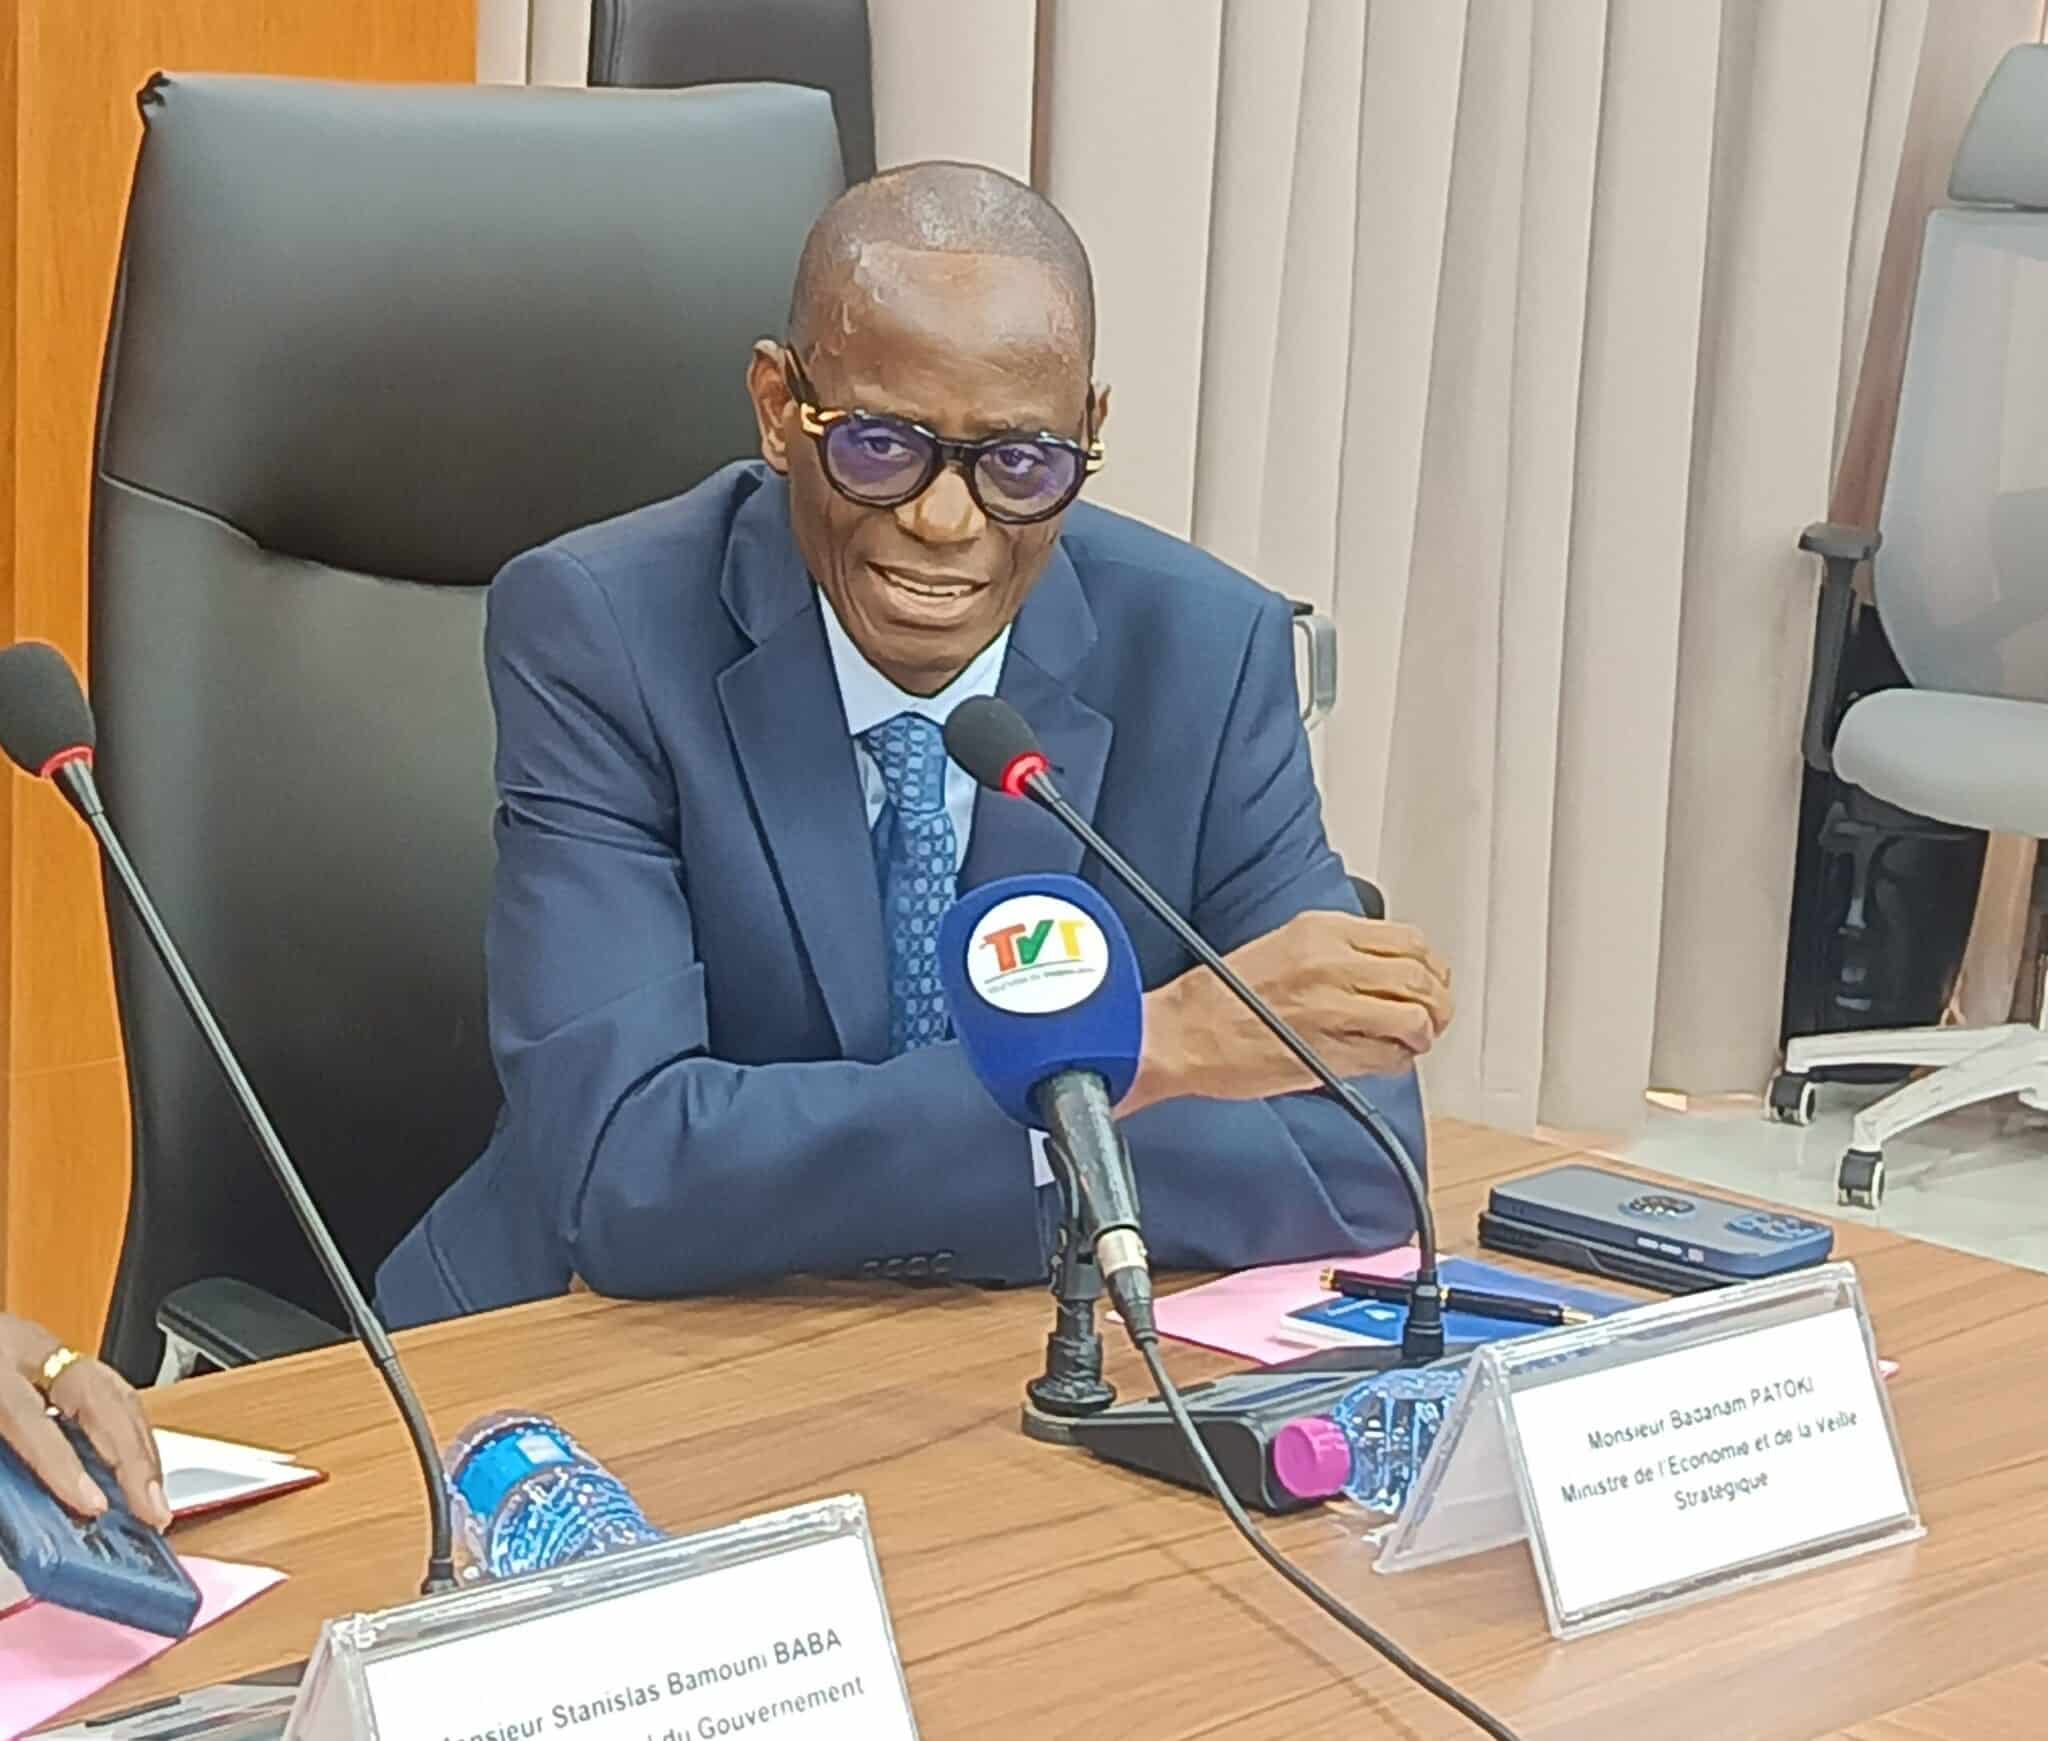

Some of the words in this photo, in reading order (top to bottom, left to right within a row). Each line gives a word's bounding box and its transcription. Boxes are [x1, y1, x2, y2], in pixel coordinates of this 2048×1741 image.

[983, 919, 1086, 972] TVT
[1587, 1419, 1665, 1450] Monsieur
[1749, 1375, 1815, 1407] PATOKI
[1560, 1473, 1629, 1503] Ministre
[1634, 1466, 1654, 1485] de
[1754, 1433, 1770, 1452] et
[1774, 1428, 1793, 1446] de
[1798, 1423, 1812, 1439] la
[1816, 1410, 1858, 1433] Veille
[443, 1715, 544, 1741] sieur
[551, 1684, 661, 1729] Stanislas
[666, 1653, 769, 1696] Bamouni
[772, 1627, 843, 1665] BABA
[697, 1675, 865, 1740] Gouvernement
